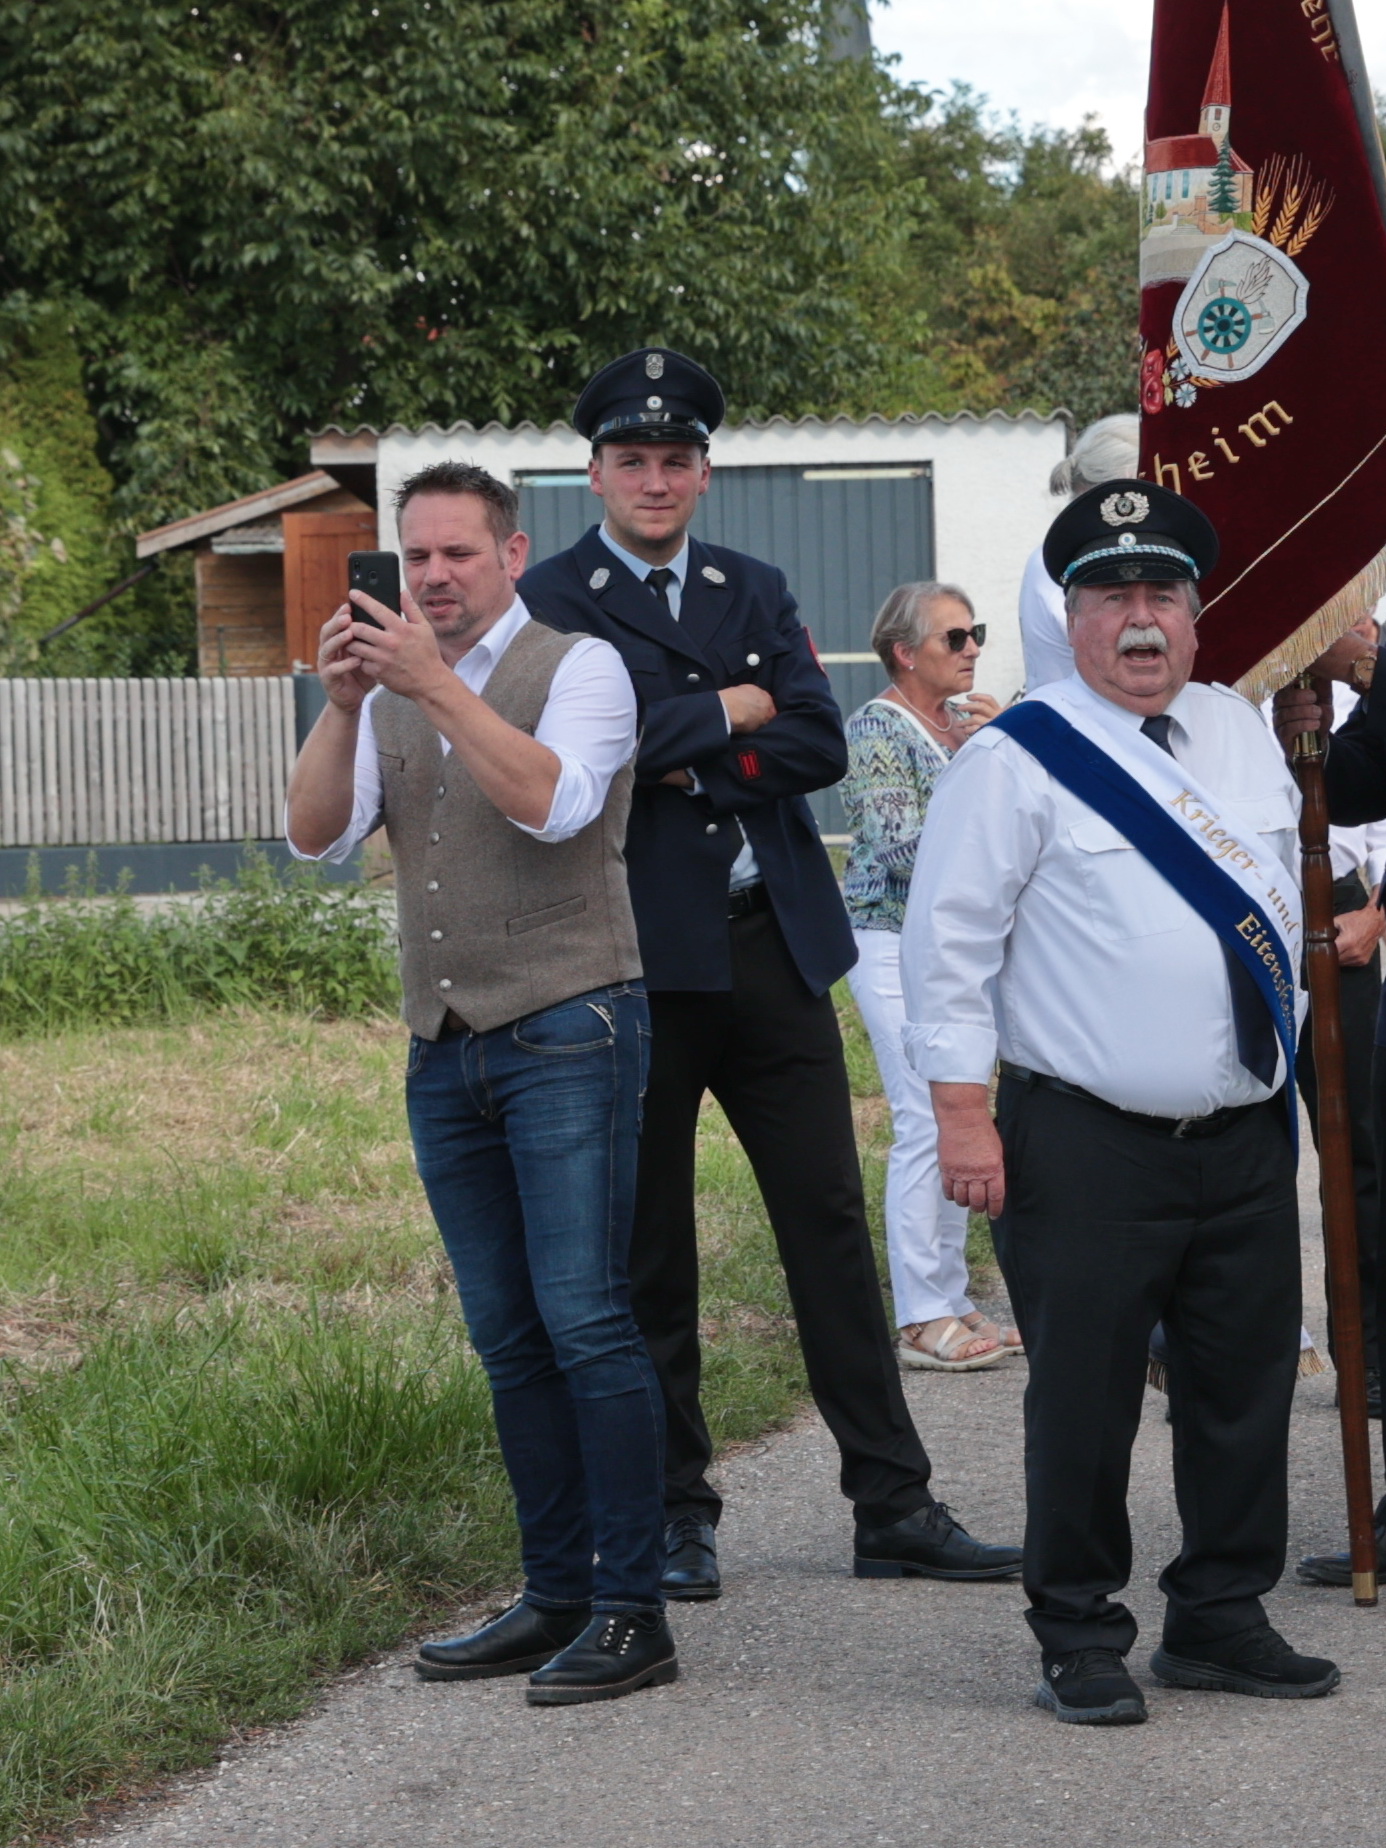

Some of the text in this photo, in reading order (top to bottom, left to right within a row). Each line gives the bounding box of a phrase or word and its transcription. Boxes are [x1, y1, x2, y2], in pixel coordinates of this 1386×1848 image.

[1139, 400, 1294, 496] heim
[1169, 788, 1300, 935] Krieger- und
